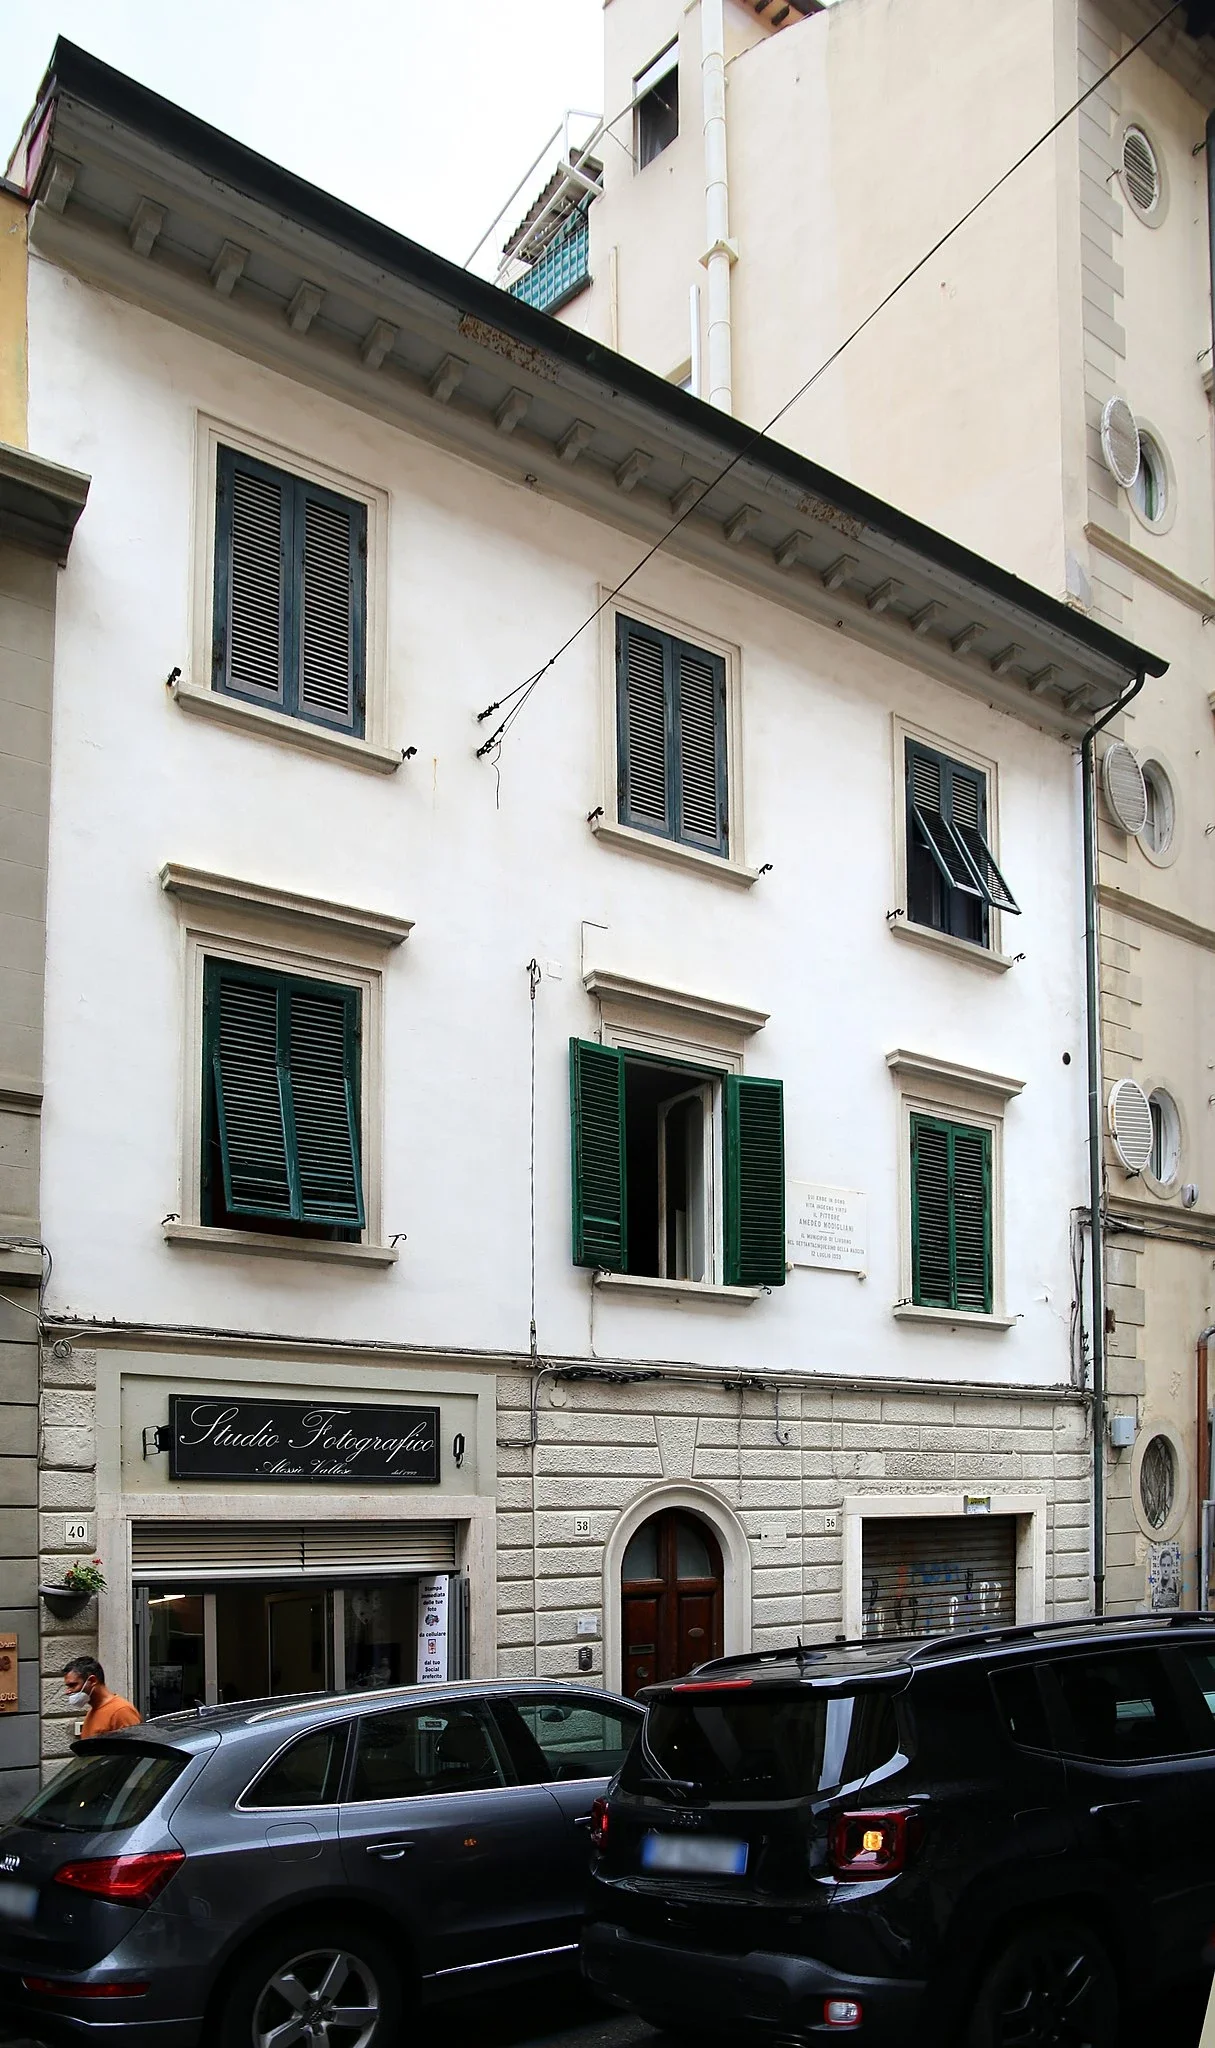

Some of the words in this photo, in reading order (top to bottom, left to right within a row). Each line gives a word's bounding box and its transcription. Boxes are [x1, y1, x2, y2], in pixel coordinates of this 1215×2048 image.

[819, 1212, 840, 1221] PITTORE
[799, 1218, 822, 1228] AMEDEO
[823, 1221, 854, 1232] MODIGLIANI
[806, 1233, 827, 1242] MUNICIPIO
[179, 1404, 280, 1447] Studio
[288, 1409, 435, 1462] Fotografico
[255, 1459, 304, 1474] Alessio
[576, 1521, 588, 1531] 38
[826, 1518, 836, 1528] 36
[68, 1525, 85, 1539] 40
